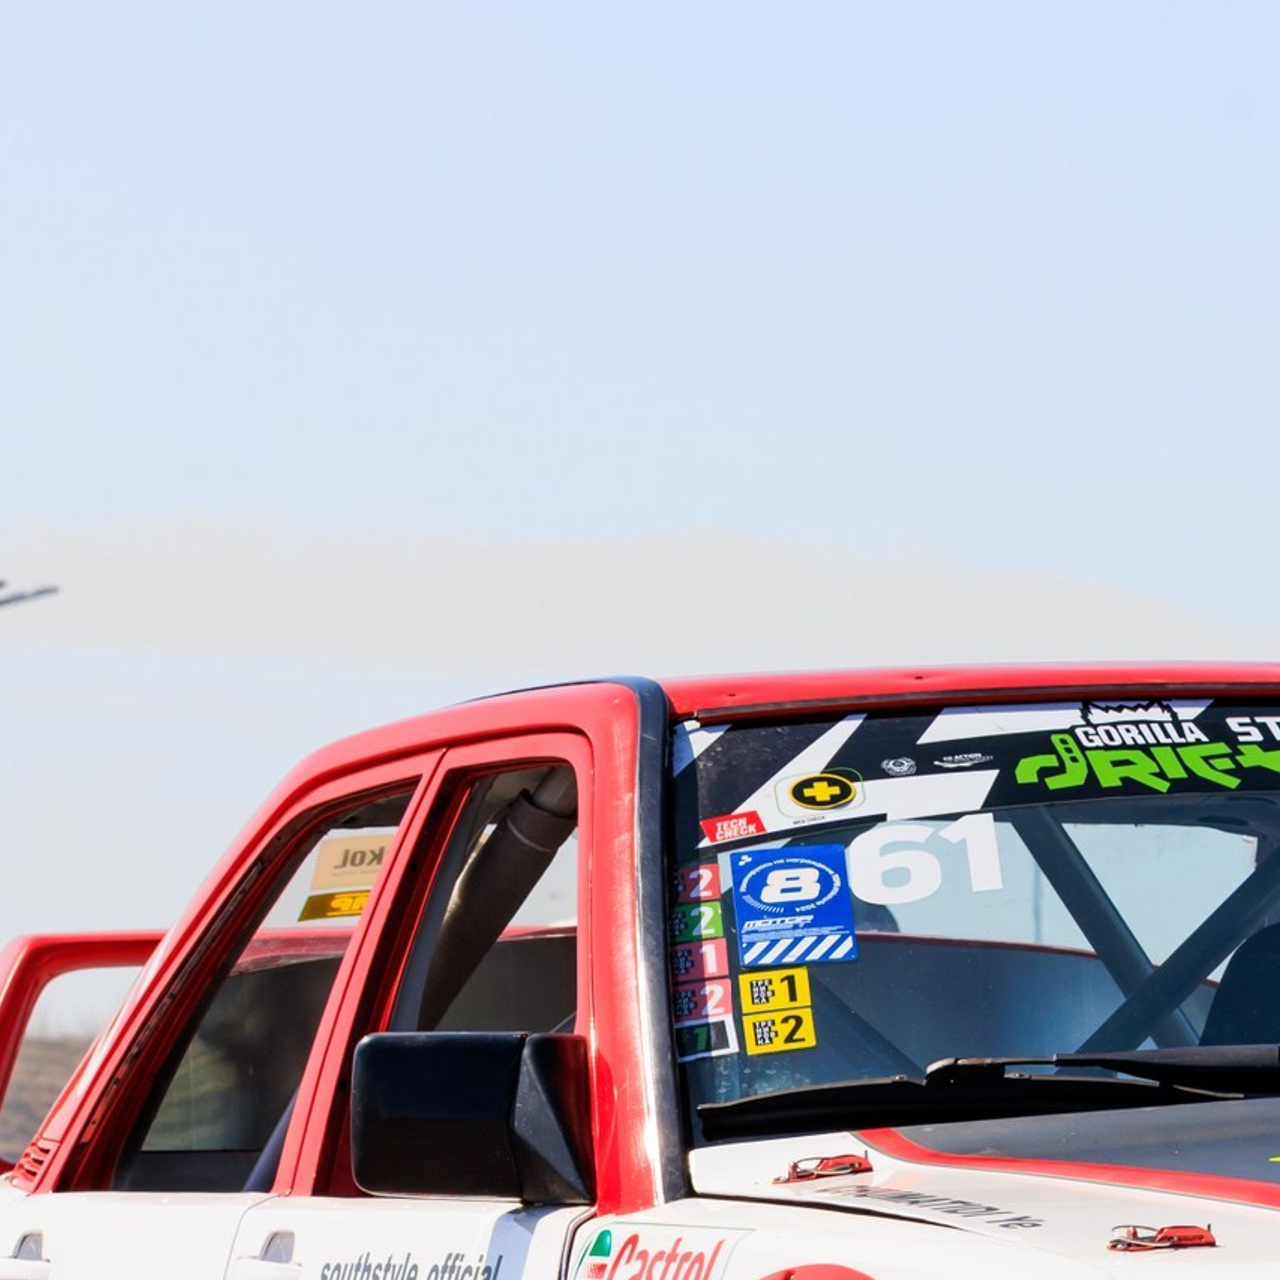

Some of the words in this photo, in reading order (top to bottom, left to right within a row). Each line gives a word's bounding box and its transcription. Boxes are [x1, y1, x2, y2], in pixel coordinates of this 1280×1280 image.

[1074, 720, 1210, 748] GORILLA
[716, 817, 748, 832] TECH
[716, 823, 758, 841] CHECK
[846, 813, 1004, 906] 61
[689, 868, 714, 899] 2
[761, 867, 821, 903] 8
[691, 905, 716, 936] 2
[698, 943, 718, 974] 1
[700, 984, 725, 1016] 2
[780, 974, 798, 1003] 1
[780, 1015, 806, 1044] 2
